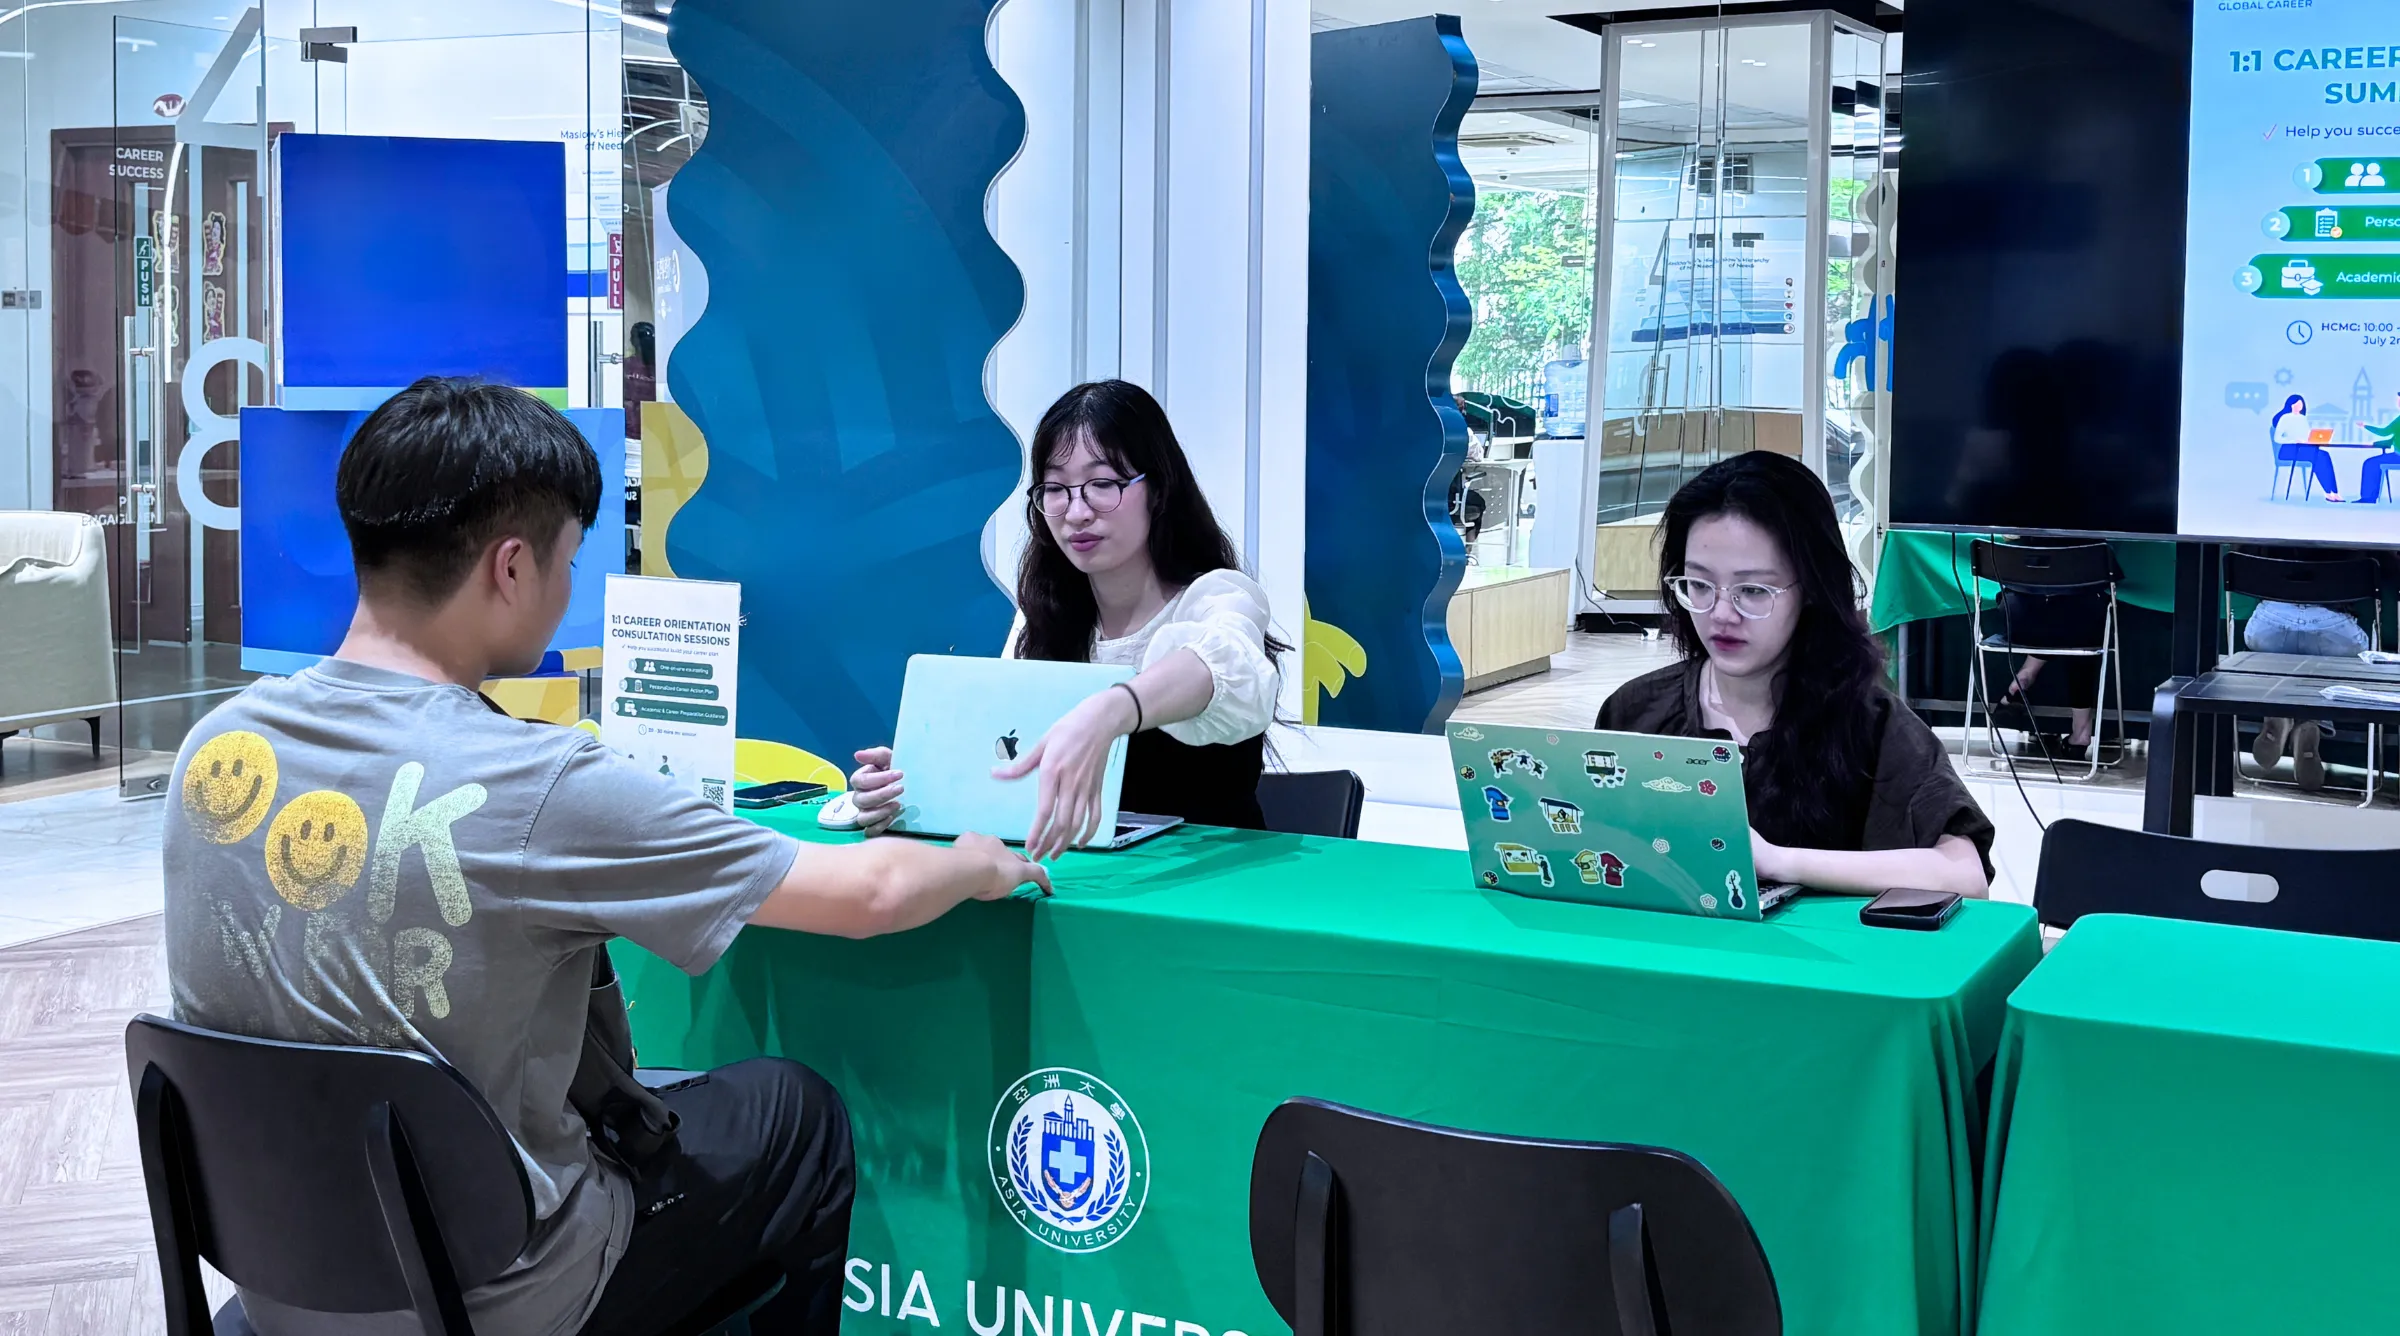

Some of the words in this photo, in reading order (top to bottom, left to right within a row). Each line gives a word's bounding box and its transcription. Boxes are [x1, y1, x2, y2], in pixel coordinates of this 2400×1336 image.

[2218, 1, 2264, 11] GLOBAL
[2266, 0, 2313, 9] CAREER
[2229, 50, 2262, 72] 1:1
[2325, 82, 2400, 104] SUM
[2285, 125, 2321, 139] Help
[2324, 128, 2352, 139] you
[115, 147, 164, 162] CAREER
[108, 164, 164, 179] SUCCESS
[2303, 168, 2311, 183] 1
[2269, 217, 2282, 231] 2
[141, 260, 150, 305] PUSH
[613, 258, 621, 307] PULL
[2241, 272, 2253, 286] 3
[2321, 322, 2360, 331] HCMC:
[2364, 322, 2393, 332] 10:00
[2363, 336, 2387, 347] July
[611, 614, 621, 624] 1:1
[624, 615, 661, 628] CAREER
[663, 619, 731, 632] ORIENTATION
[611, 628, 681, 642] CONSULTATION
[684, 634, 730, 646] SESSIONS
[1685, 757, 1710, 766] acer
[1012, 1073, 1126, 1121] 亞洲大學
[998, 1175, 1028, 1222] ASIA
[1037, 1195, 1137, 1247] UNIVERSITY
[966, 1279, 1250, 1336] UNIV
